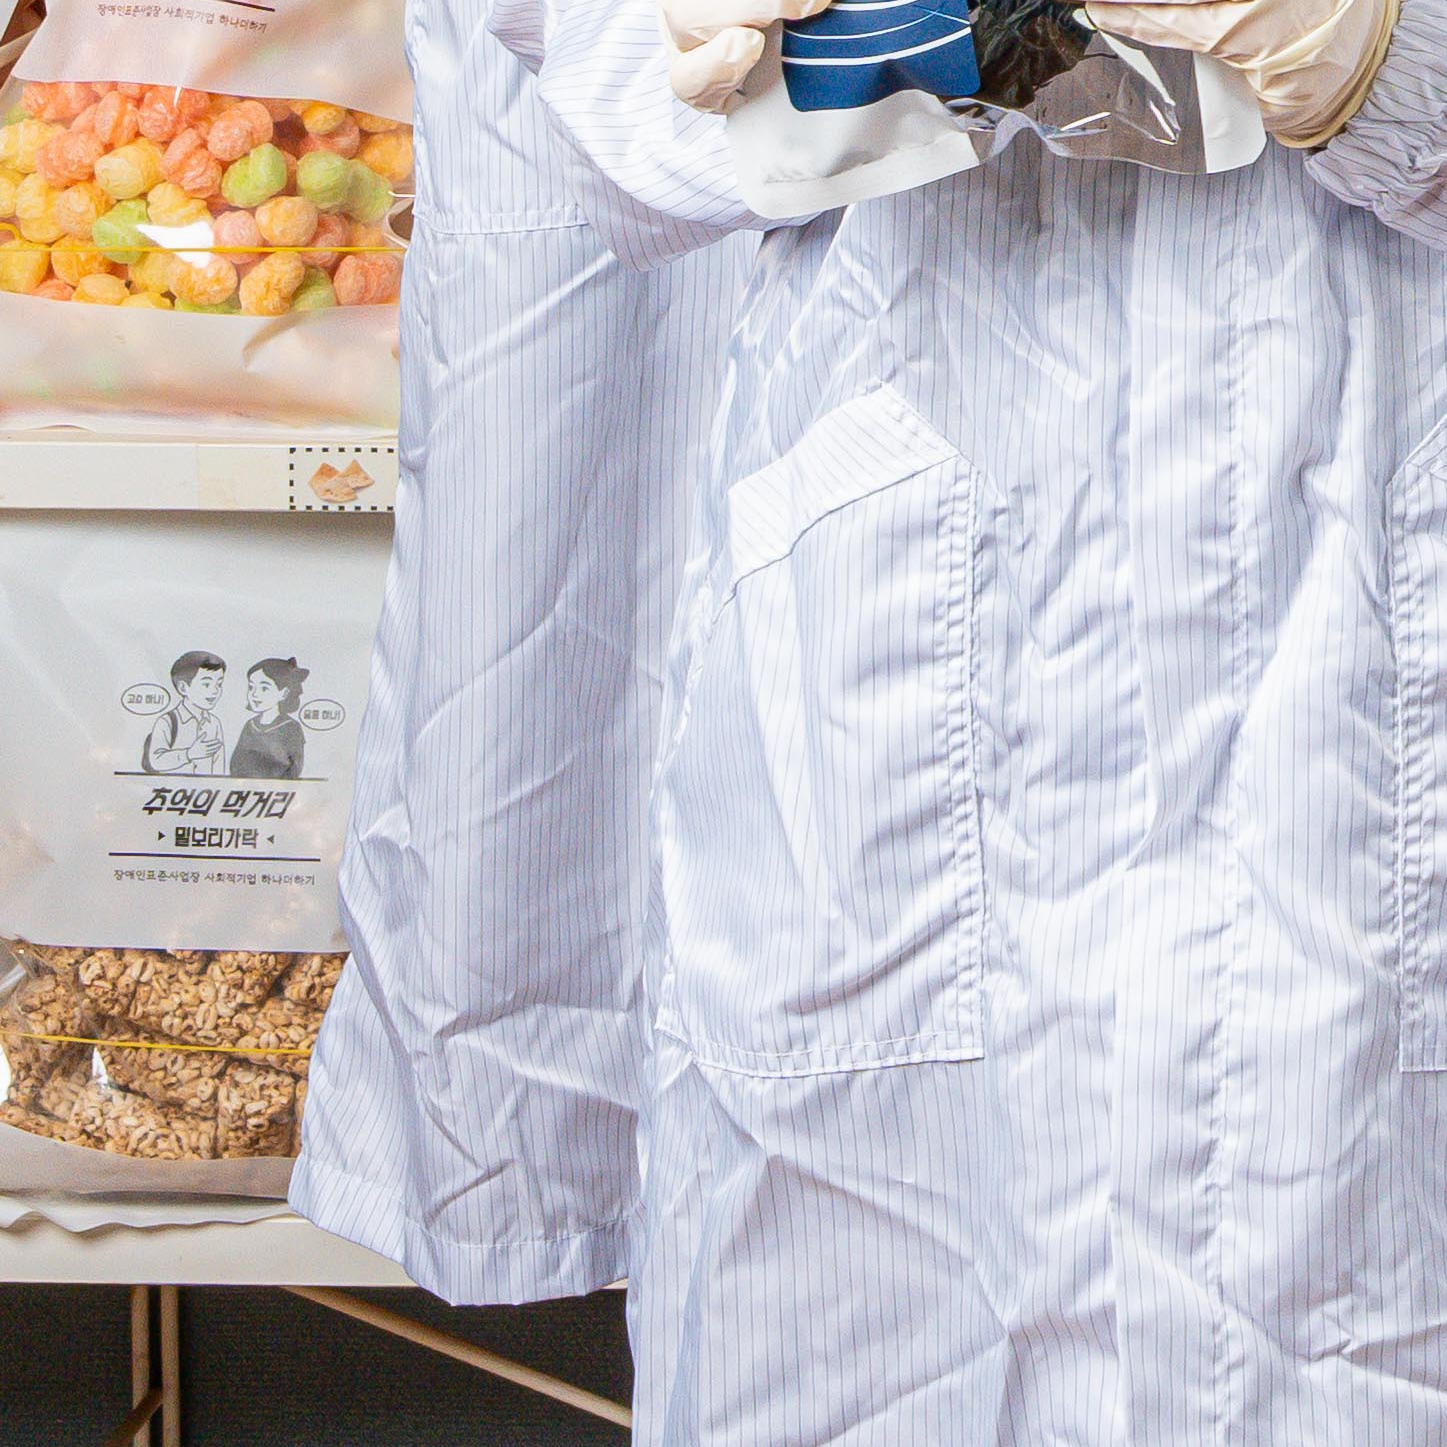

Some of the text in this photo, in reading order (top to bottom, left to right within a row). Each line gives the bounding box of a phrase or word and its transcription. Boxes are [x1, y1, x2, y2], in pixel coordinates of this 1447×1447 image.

[163, 7, 215, 24] 사회적기업
[142, 787, 296, 819] 추억의 먹거리
[174, 826, 259, 849] 밀보리가락
[113, 869, 316, 887] 장애인표준사업장 사회적기업 하나더하기
